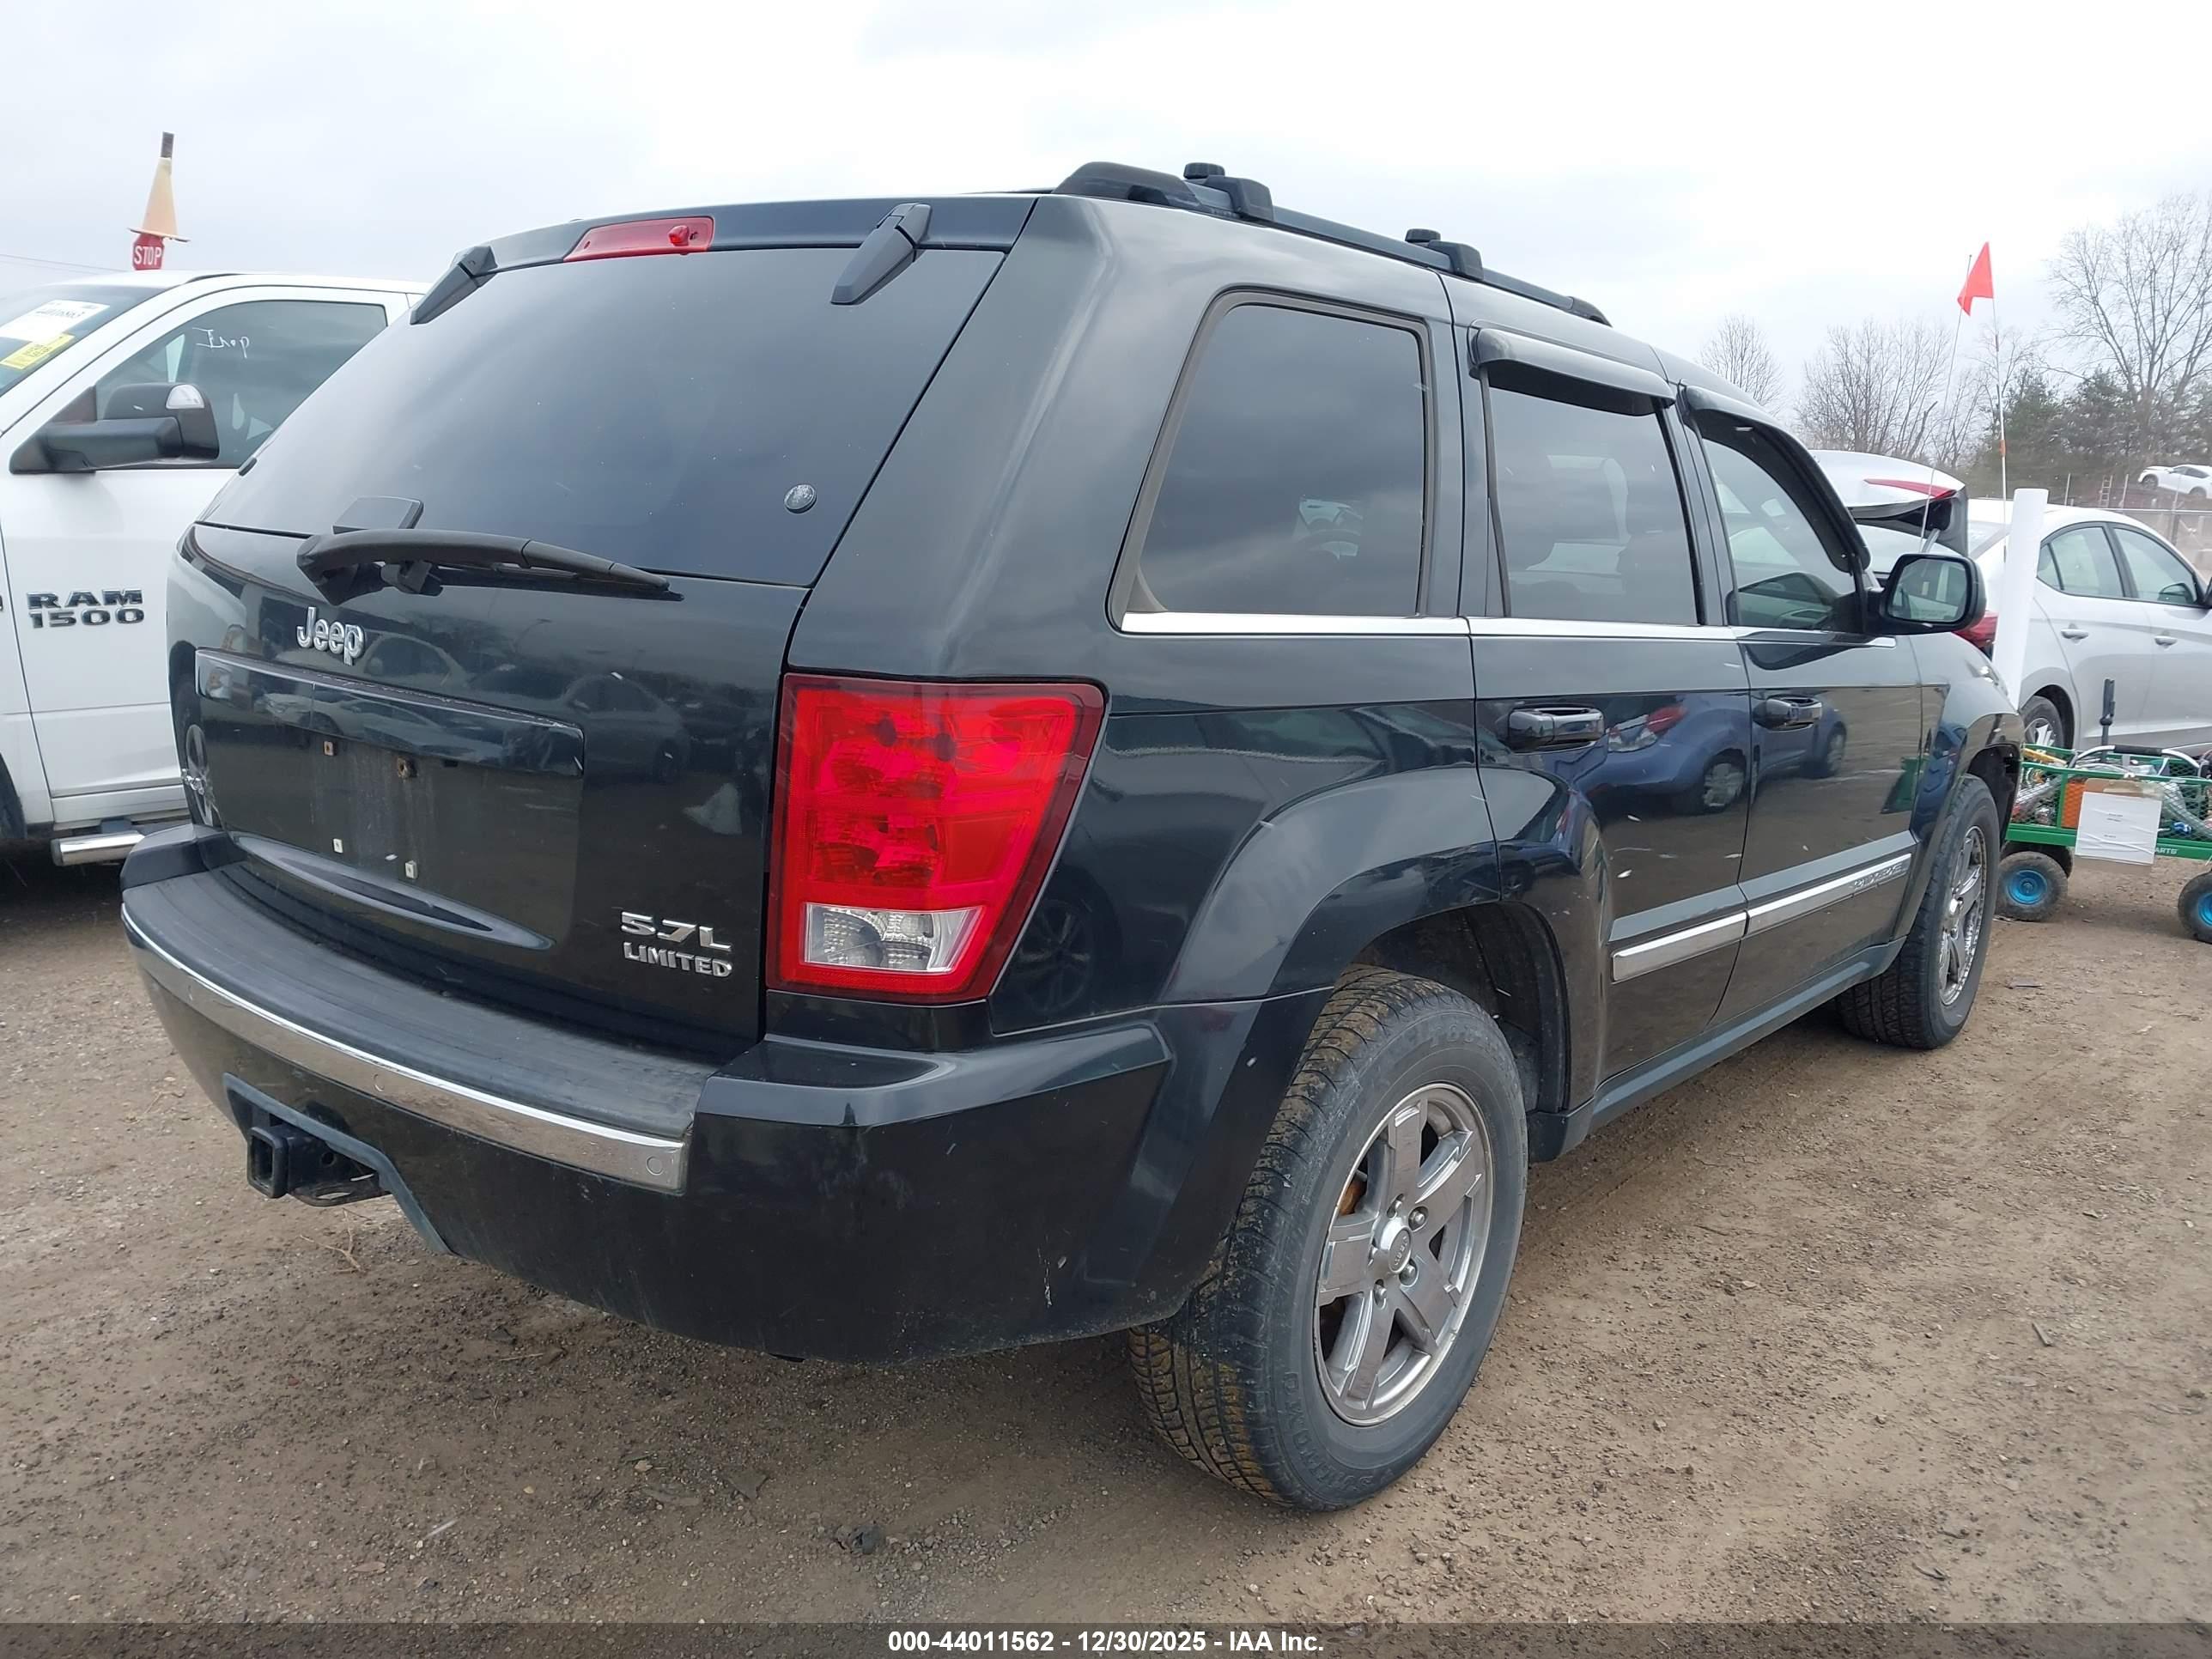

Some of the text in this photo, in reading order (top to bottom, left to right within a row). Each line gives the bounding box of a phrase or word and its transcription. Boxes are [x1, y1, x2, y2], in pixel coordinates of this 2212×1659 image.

[134, 245, 162, 265] STOP
[26, 588, 143, 610] RAM
[28, 608, 145, 629] 1500
[296, 606, 365, 667] Jeep
[623, 942, 732, 977] LIMITED
